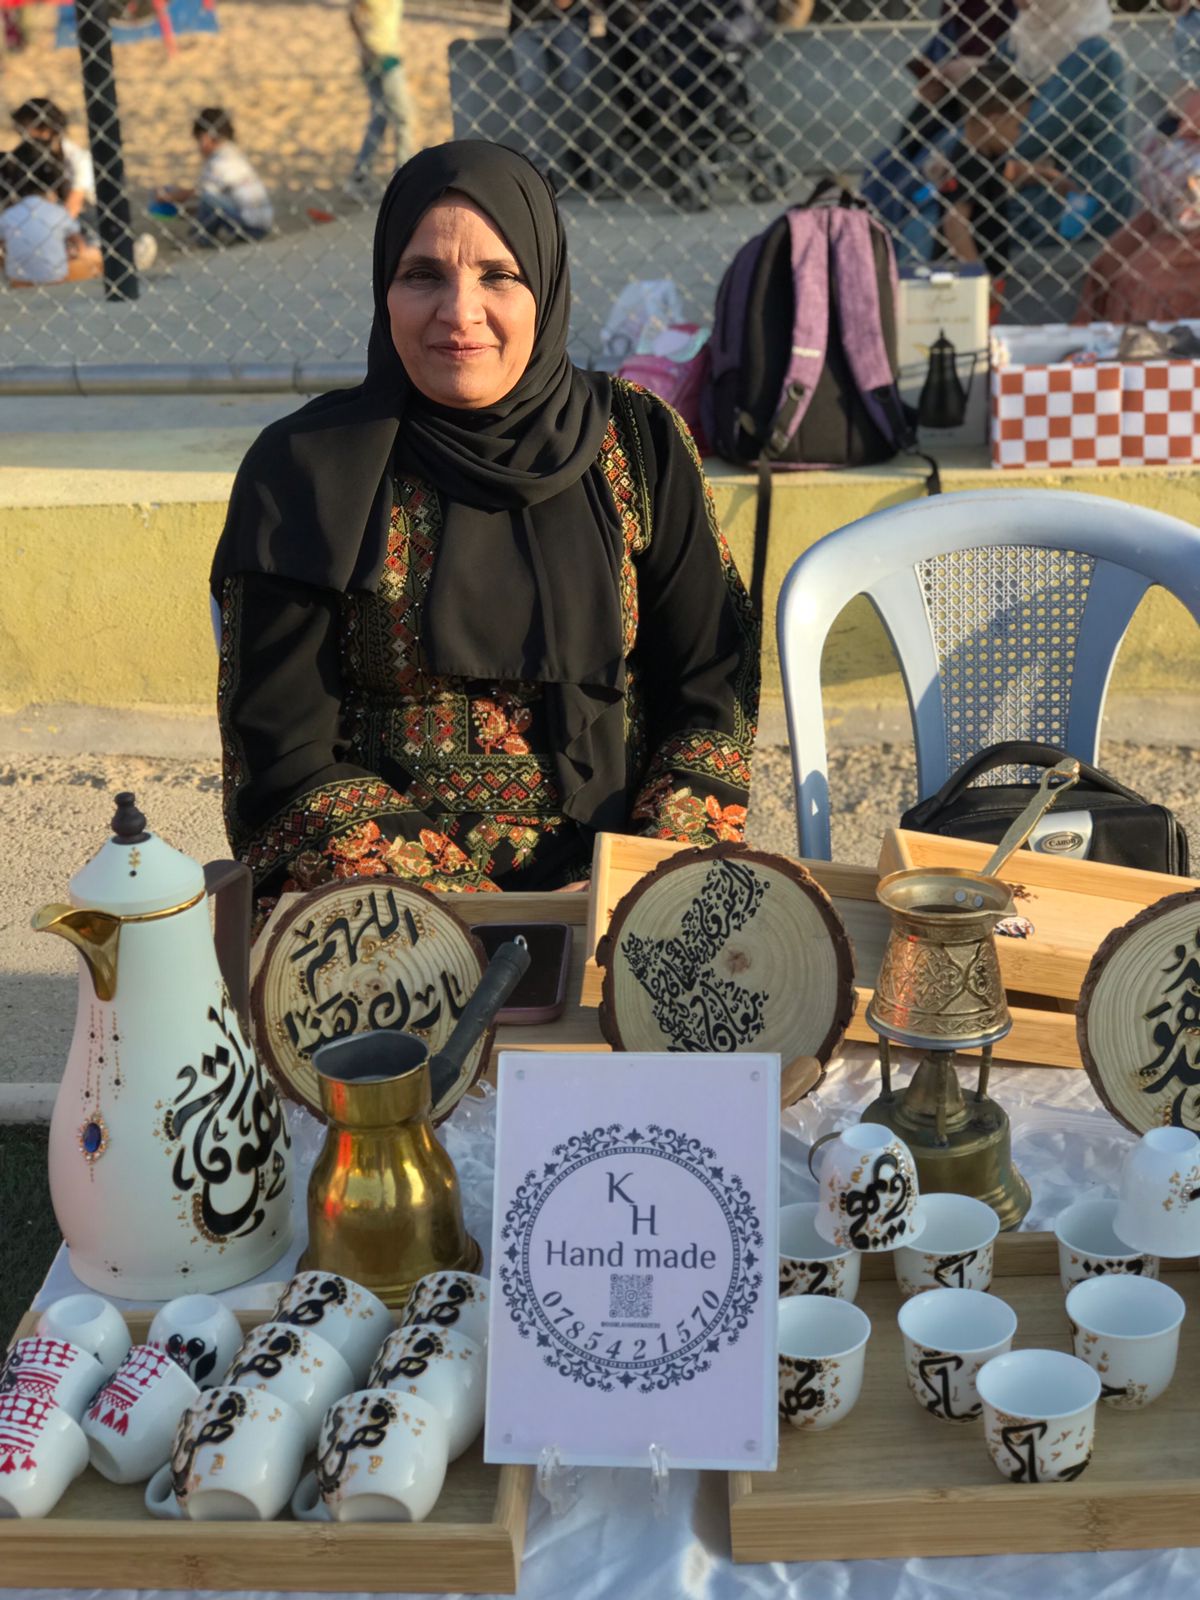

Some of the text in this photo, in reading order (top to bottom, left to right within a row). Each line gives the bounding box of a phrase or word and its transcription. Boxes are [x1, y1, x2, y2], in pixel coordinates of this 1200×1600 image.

[1048, 837, 1077, 848] Canon
[605, 1171, 636, 1204] K
[629, 1204, 660, 1236] H
[544, 1239, 717, 1270] Hand made
[542, 1289, 720, 1361] 0785421570
